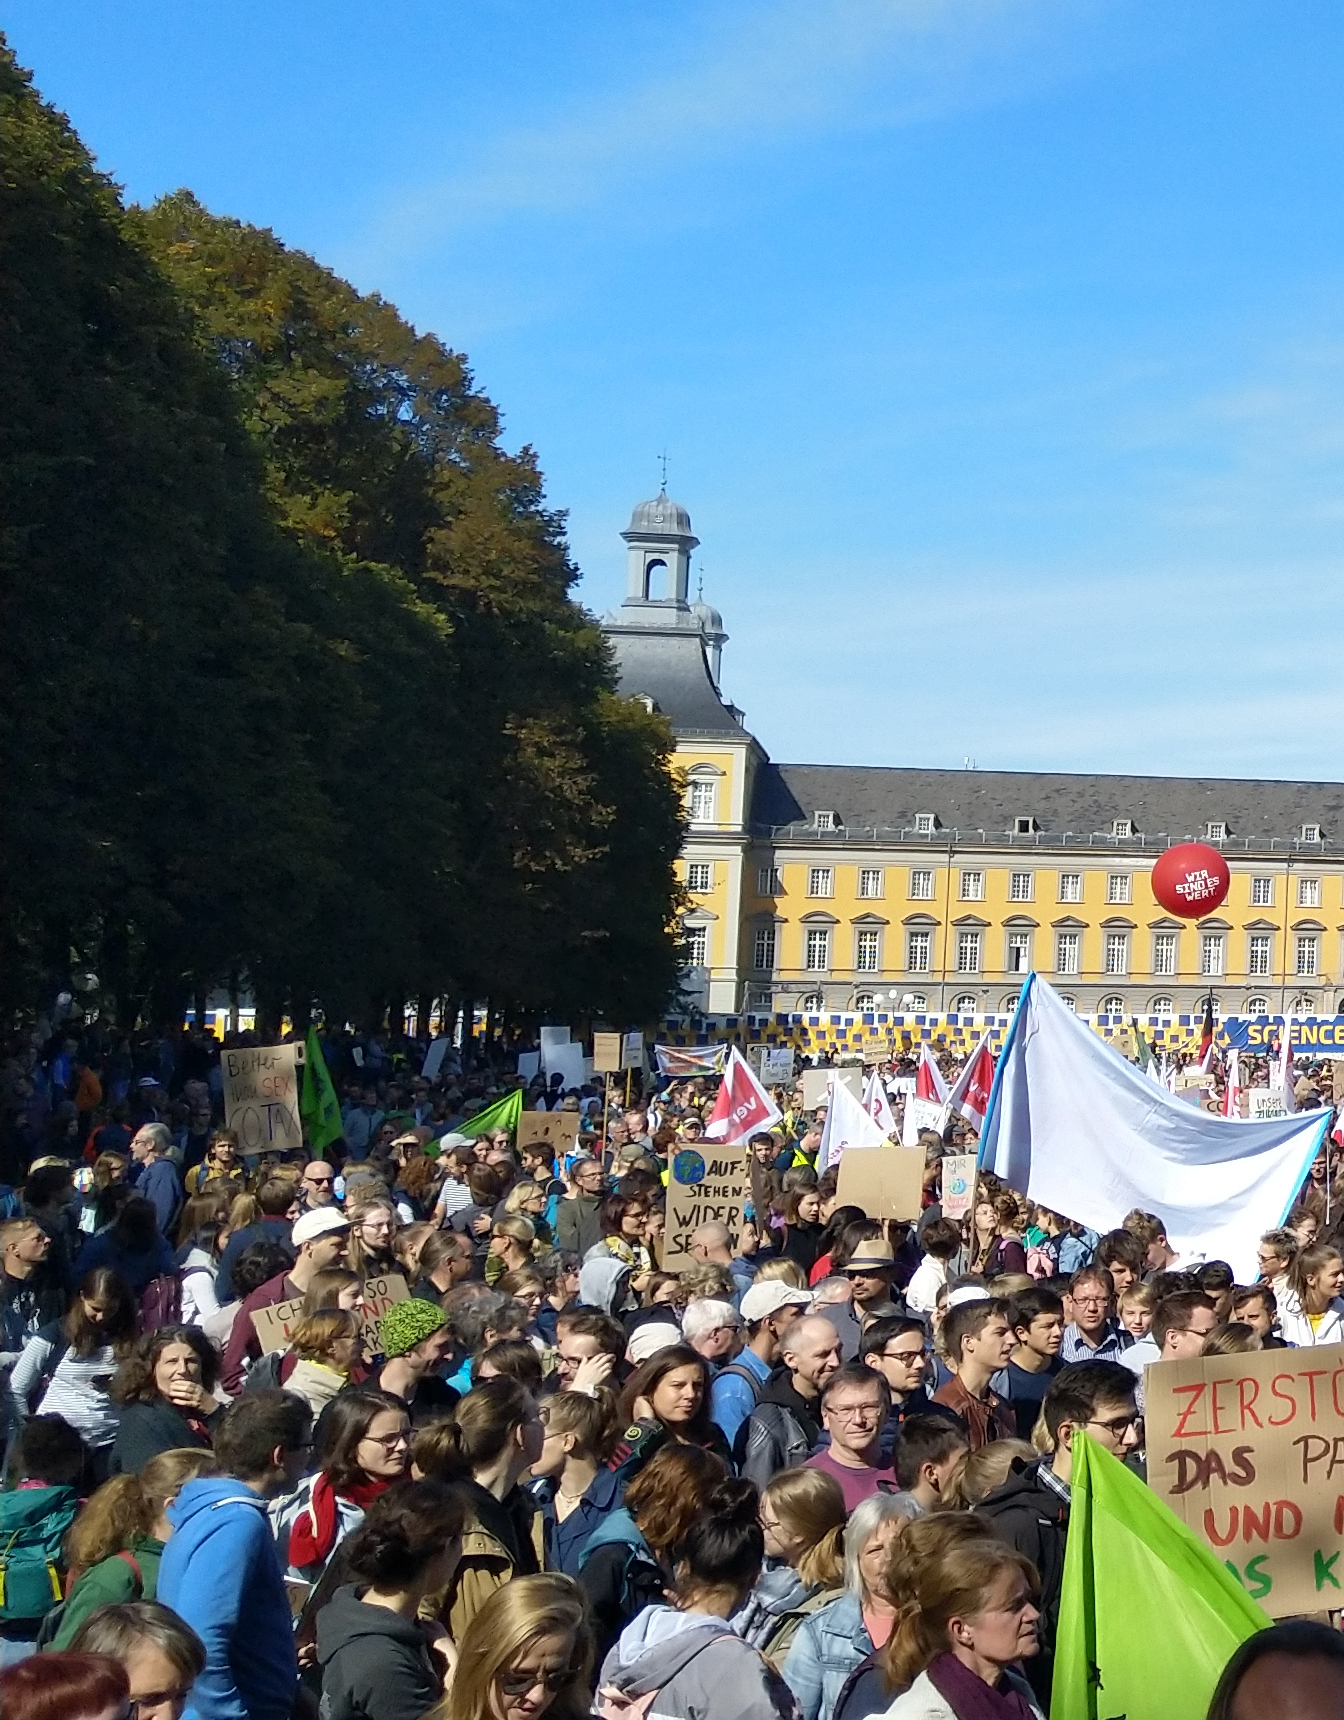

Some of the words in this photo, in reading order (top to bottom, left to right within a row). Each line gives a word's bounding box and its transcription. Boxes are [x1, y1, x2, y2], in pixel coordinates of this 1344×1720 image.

[1175, 882, 1207, 894] SIND
[1206, 876, 1220, 888] ES
[1185, 869, 1209, 883] WIR
[262, 1076, 292, 1098] SEX
[261, 1100, 301, 1141] TAX
[706, 1160, 745, 1177] AUF-
[946, 1158, 966, 1170] MIR
[684, 1183, 743, 1198] STEHEN
[672, 1204, 740, 1229] WIDER
[265, 1302, 302, 1325] ICH
[1165, 1445, 1256, 1495] DAS
[1203, 1499, 1304, 1547] UND
